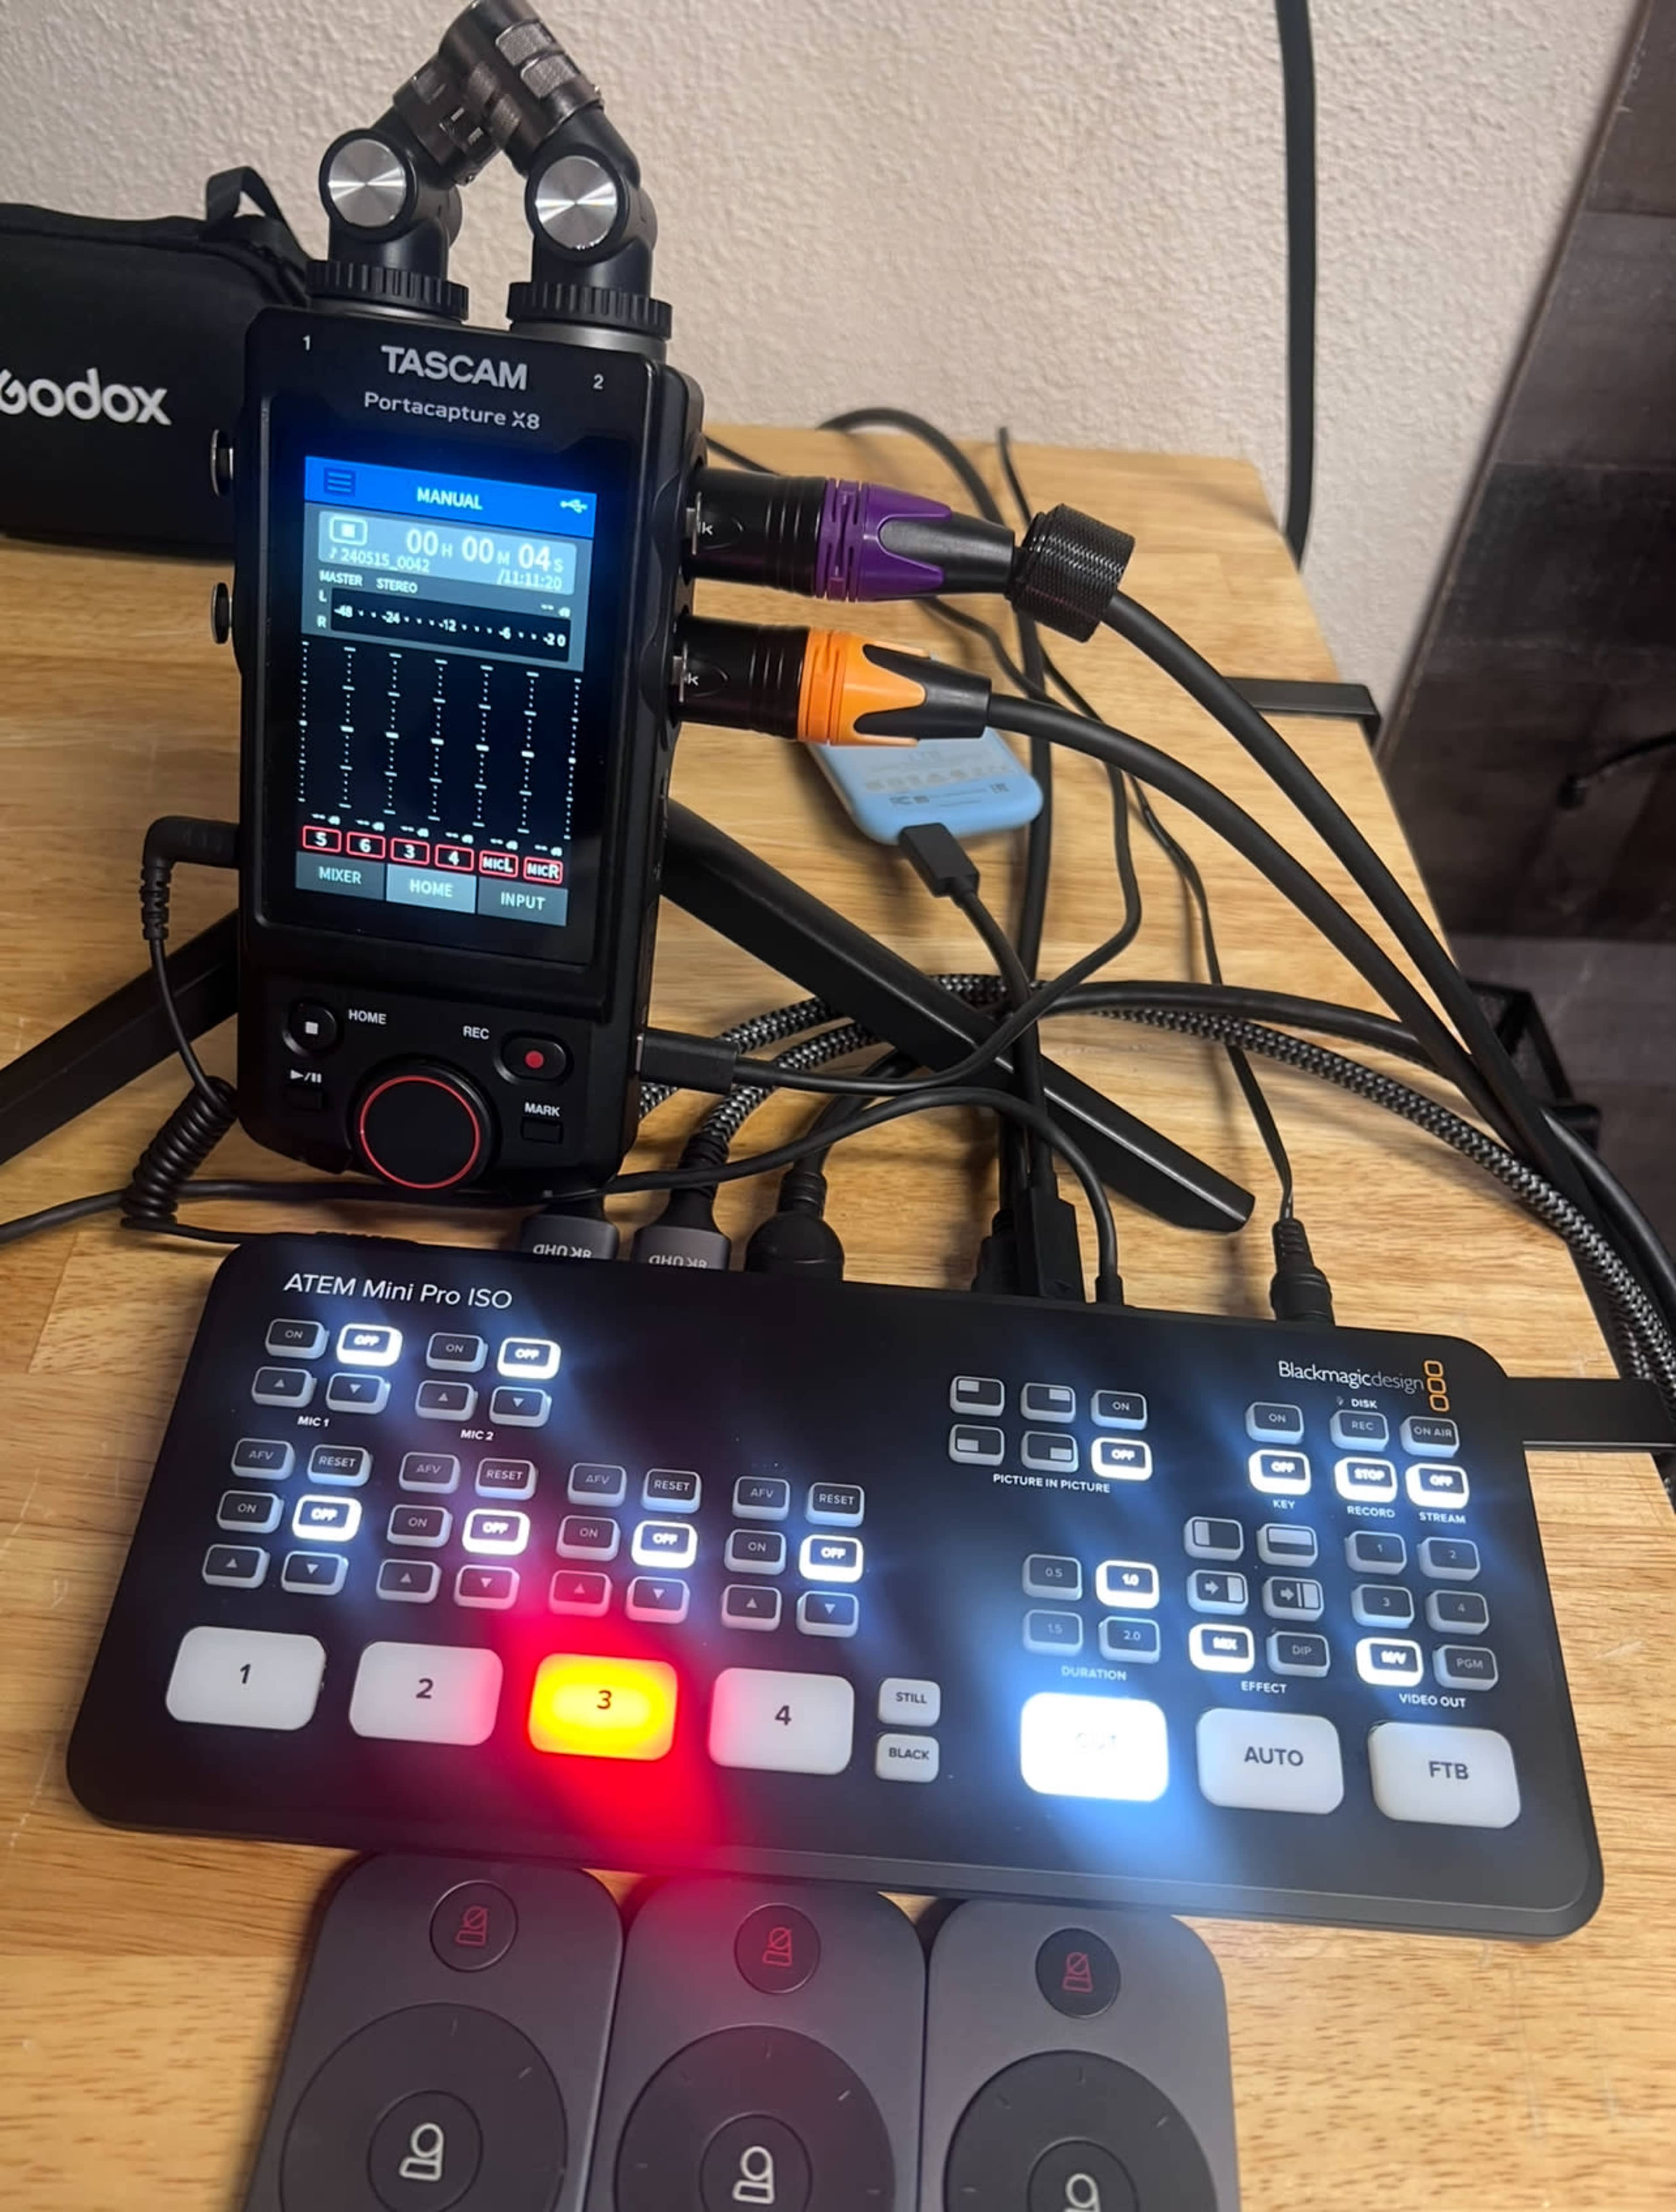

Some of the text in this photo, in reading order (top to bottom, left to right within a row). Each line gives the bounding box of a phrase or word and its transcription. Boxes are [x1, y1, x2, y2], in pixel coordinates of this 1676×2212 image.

[303, 336, 310, 350] 1
[381, 345, 527, 390] TASCAM
[593, 374, 604, 389] 2
[0, 368, 172, 425] Godox
[364, 391, 540, 430] Portacapture X8
[417, 487, 483, 510] MANUAL
[406, 528, 563, 573] 00 H 00 M 04 S
[319, 570, 418, 593] MASTER STEREO
[319, 590, 326, 602] L
[317, 616, 326, 628] R
[315, 833, 327, 847] 5
[360, 839, 371, 853] 6
[404, 845, 415, 859] 3
[449, 851, 460, 866] 4
[319, 866, 361, 885] MIXER
[409, 879, 453, 898] HOME
[501, 892, 546, 911] INPUT
[348, 1009, 387, 1025] HOME
[463, 1025, 490, 1040] REC
[525, 1102, 560, 1117] MARK
[533, 1244, 568, 1257] UHD
[649, 1255, 685, 1266] UHD
[284, 1273, 513, 1309] ATEM Mini Pro ISO
[285, 1329, 303, 1340] ON
[446, 1343, 464, 1354] ON
[1112, 1401, 1130, 1411] ON
[1351, 1398, 1377, 1409] DISK
[297, 1415, 330, 1427] MIC 1
[1268, 1413, 1286, 1423] ON
[1351, 1420, 1374, 1431] REC
[1414, 1426, 1453, 1438] ON AIR
[460, 1429, 494, 1441] MIC 2
[248, 1450, 274, 1461] AFV
[1111, 1449, 1135, 1461] OFF
[318, 1456, 356, 1468] RESET
[416, 1464, 442, 1475] AFV
[485, 1469, 523, 1481] RESET
[1353, 1468, 1386, 1482] STOP
[585, 1474, 611, 1485] AFV
[654, 1479, 691, 1492] RESET
[993, 1473, 1111, 1493] PICTURE IN PICTURE
[749, 1487, 774, 1498] AFV
[819, 1493, 855, 1506] RESET
[1273, 1499, 1295, 1510] KEY
[237, 1503, 257, 1514] ON
[1347, 1506, 1395, 1518] RECORD
[408, 1516, 427, 1527] ON
[1418, 1512, 1466, 1524] STREAM
[580, 1528, 599, 1538] ON
[748, 1542, 767, 1553] ON
[1377, 1545, 1383, 1554] 1
[1449, 1550, 1456, 1559] 2
[1045, 1567, 1063, 1578] 0.5
[1382, 1597, 1391, 1608] 3
[1457, 1602, 1466, 1613] 4
[1123, 1630, 1141, 1641] 2.0
[1292, 1645, 1312, 1656] DIP
[1456, 1658, 1484, 1669] PGM
[239, 1663, 251, 1684] 1
[1061, 1665, 1127, 1681] DURATION
[416, 1678, 434, 1699] 2
[1240, 1680, 1288, 1694] EFFECT
[596, 1689, 613, 1710] 3
[895, 1691, 927, 1704] STILL
[1399, 1692, 1466, 1709] VIDEO OUT
[775, 1705, 792, 1725] 4
[888, 1747, 930, 1761] BLACK
[1244, 1746, 1304, 1767] AUTO
[1429, 1759, 1469, 1781] FTB
